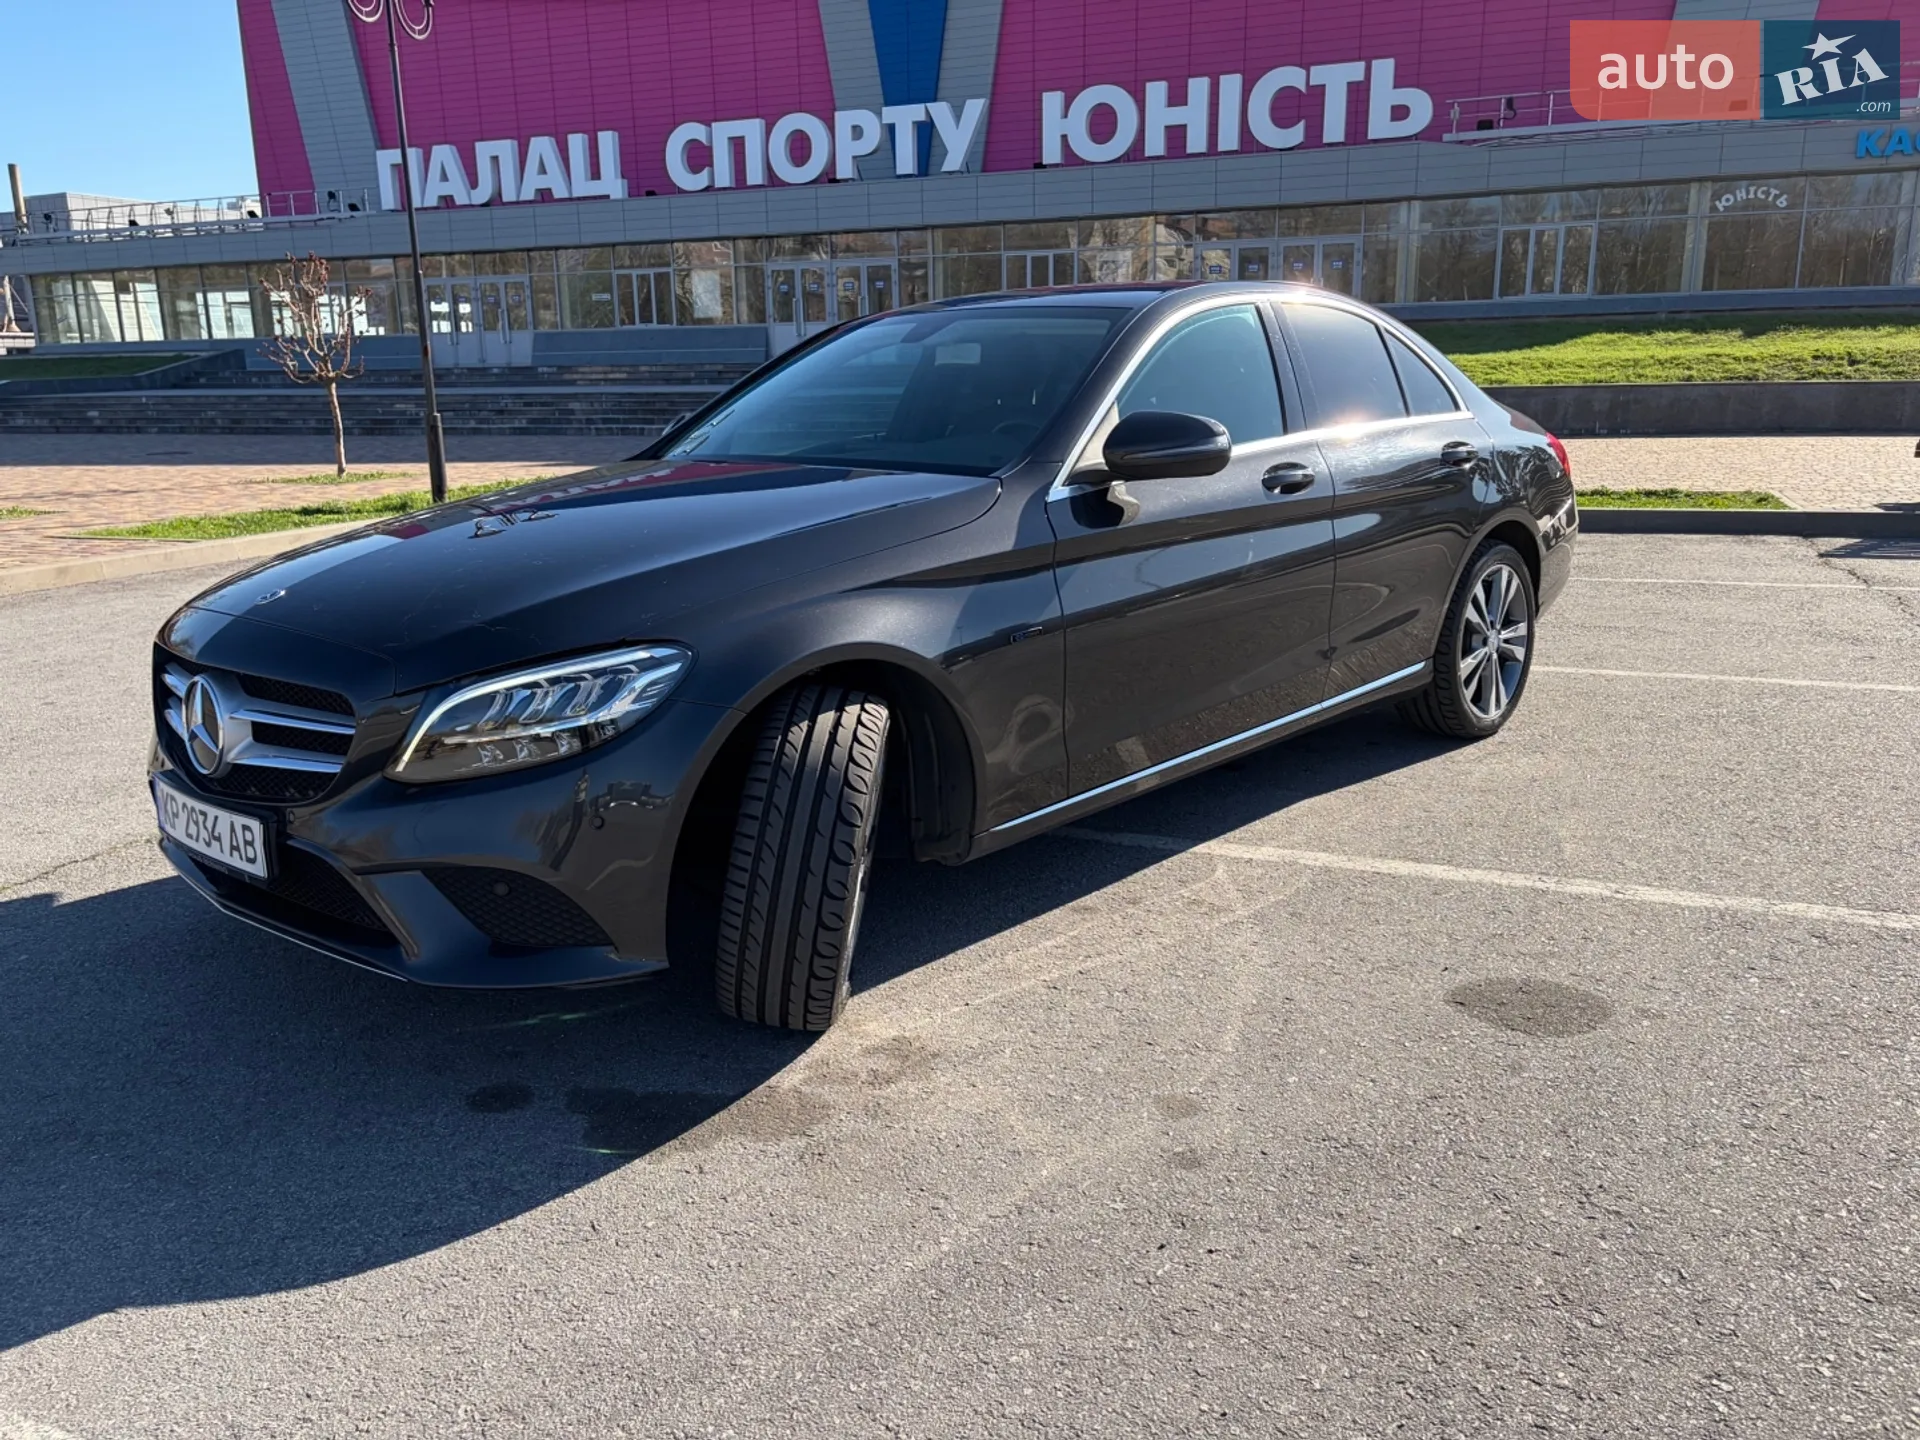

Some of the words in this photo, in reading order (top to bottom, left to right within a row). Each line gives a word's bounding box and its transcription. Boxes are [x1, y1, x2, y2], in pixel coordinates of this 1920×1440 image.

[376, 130, 629, 211] ПАЛАЦ
[665, 98, 988, 192] СПОРТУ
[1040, 57, 1434, 166] ЮНІСТЬ
[1856, 127, 1920, 159] КА
[1714, 185, 1789, 212] ЮНІСТЬ
[182, 801, 225, 855] 2934
[229, 820, 258, 865] AB
